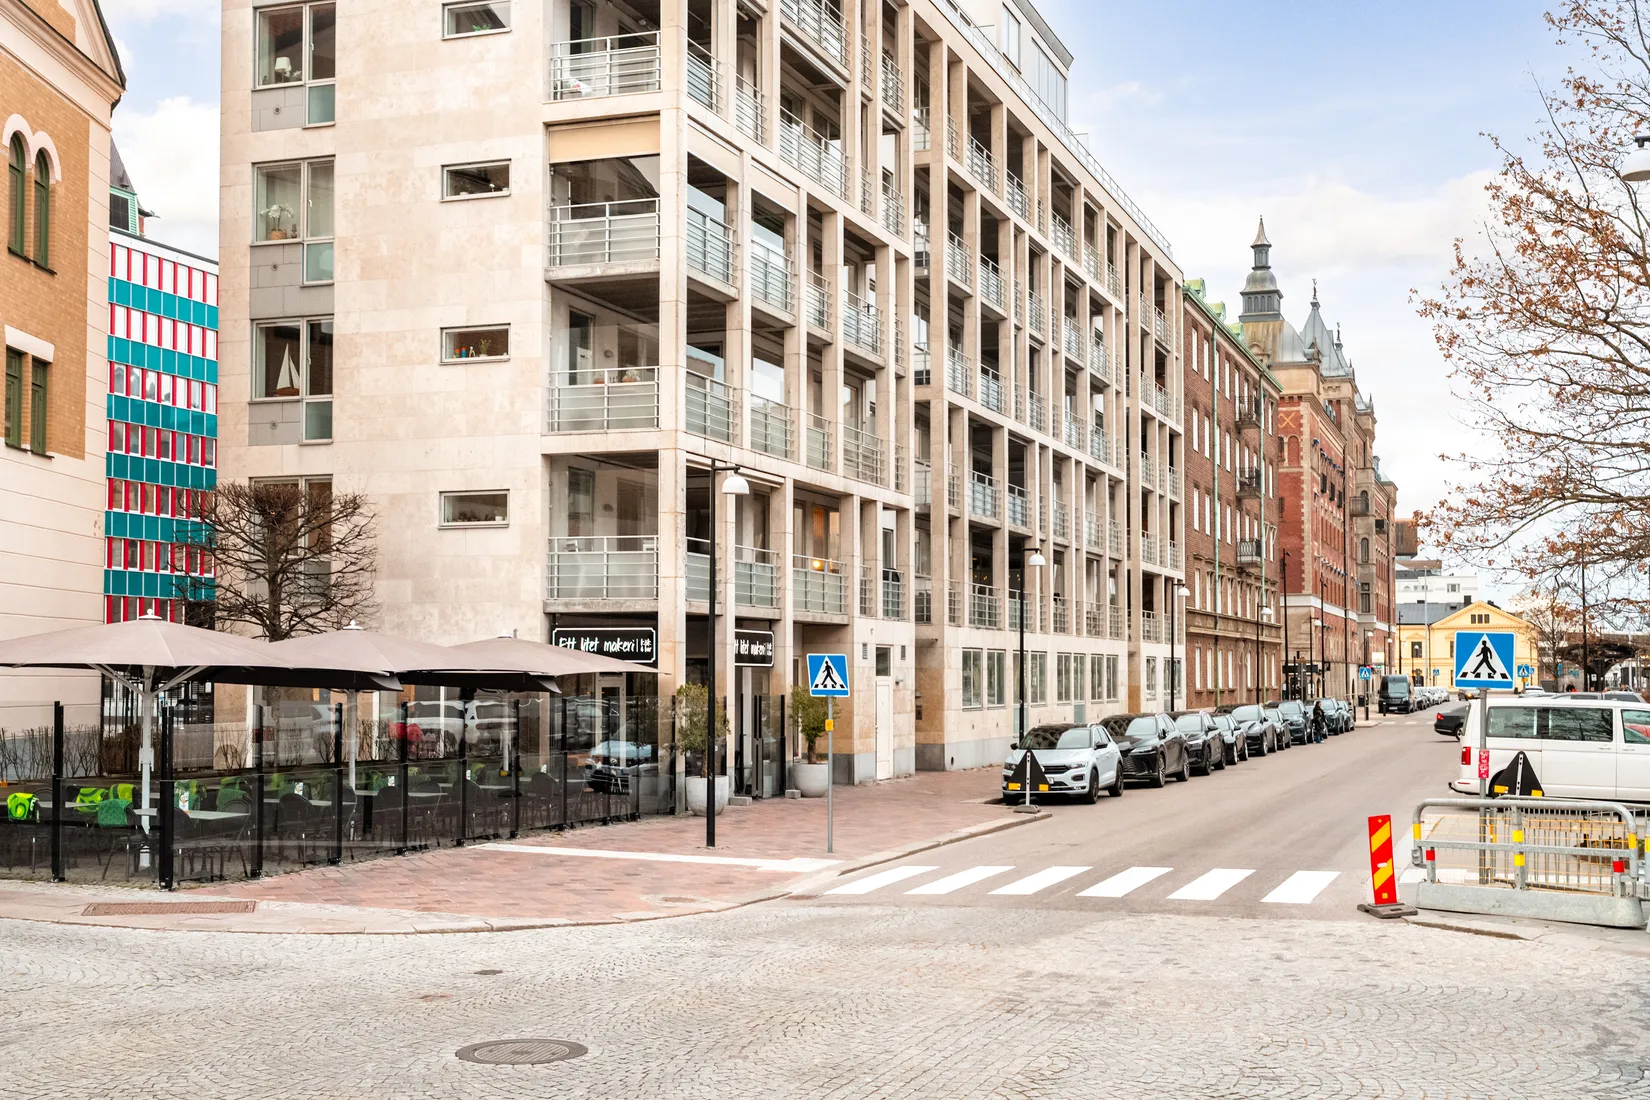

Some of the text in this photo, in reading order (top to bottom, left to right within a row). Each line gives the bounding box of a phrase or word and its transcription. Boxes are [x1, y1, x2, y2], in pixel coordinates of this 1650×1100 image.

[559, 637, 635, 653] Ett litet makeri
